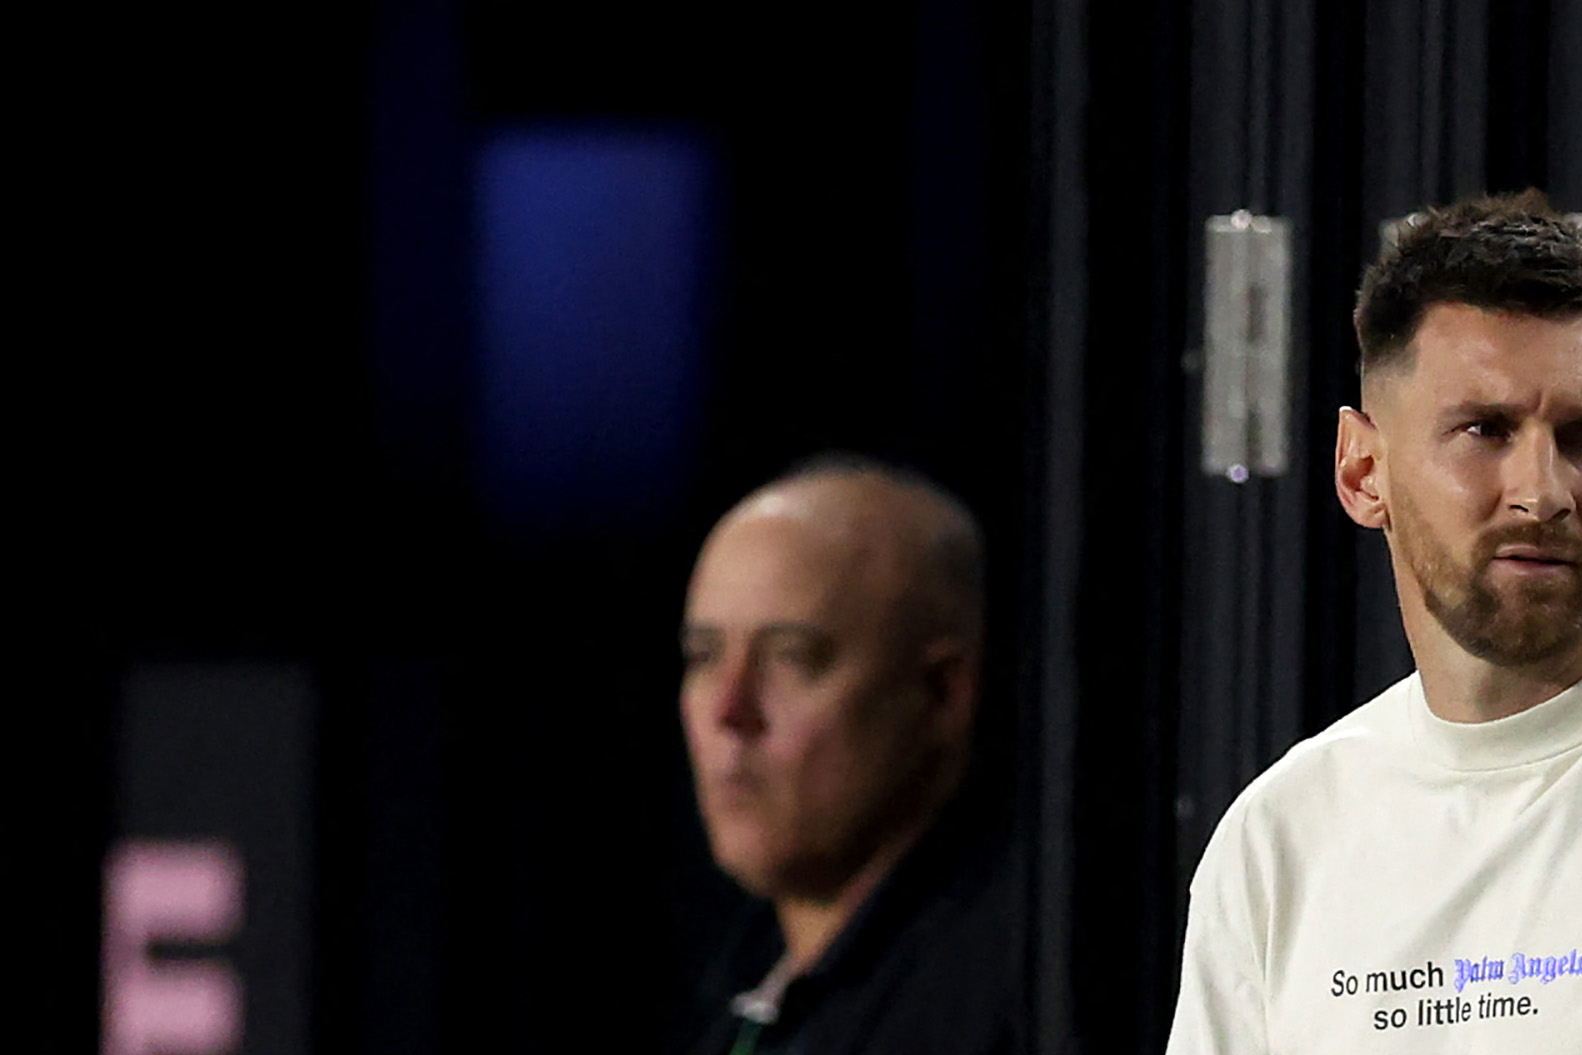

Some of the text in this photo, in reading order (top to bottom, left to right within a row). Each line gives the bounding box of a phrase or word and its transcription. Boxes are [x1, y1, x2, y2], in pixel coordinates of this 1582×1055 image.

[1331, 970, 1358, 997] So
[1366, 961, 1444, 993] much
[1454, 955, 1504, 993] Palm
[1374, 993, 1539, 1030] so little time.
